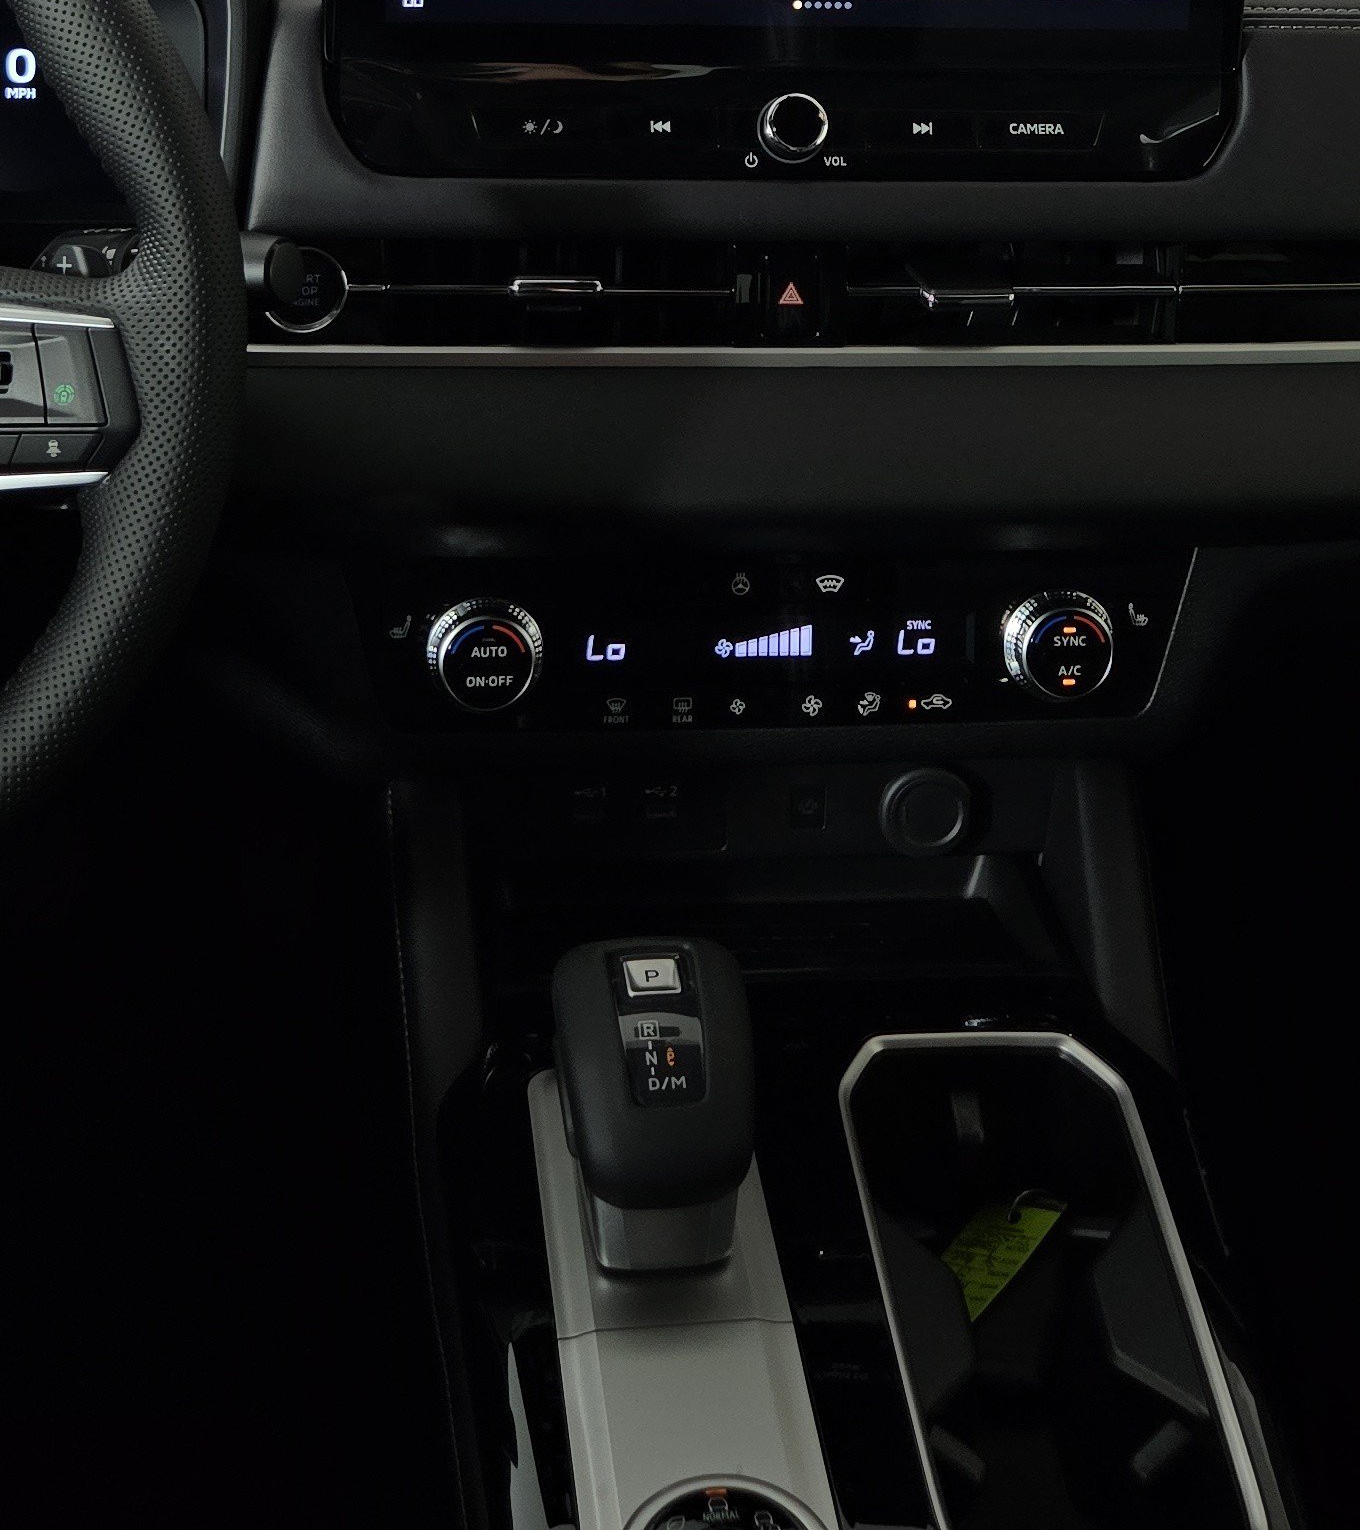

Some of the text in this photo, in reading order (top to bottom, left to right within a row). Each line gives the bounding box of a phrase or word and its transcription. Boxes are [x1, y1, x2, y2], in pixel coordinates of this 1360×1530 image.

[4, 48, 36, 84] 0
[4, 87, 37, 100] MPH
[1009, 123, 1064, 135] CAMERA
[823, 156, 847, 167] VOL
[906, 619, 932, 630] SYNC
[586, 634, 626, 662] Lo
[897, 630, 936, 656] Lo
[1053, 635, 1087, 648] SYNC
[471, 646, 508, 658] AUTO
[1058, 664, 1082, 677] A/C
[603, 714, 630, 725] FRONT
[671, 714, 694, 725] REAR
[644, 969, 660, 983] P
[642, 1023, 655, 1037] R
[645, 1051, 658, 1066] N
[648, 1075, 687, 1091] D/M
